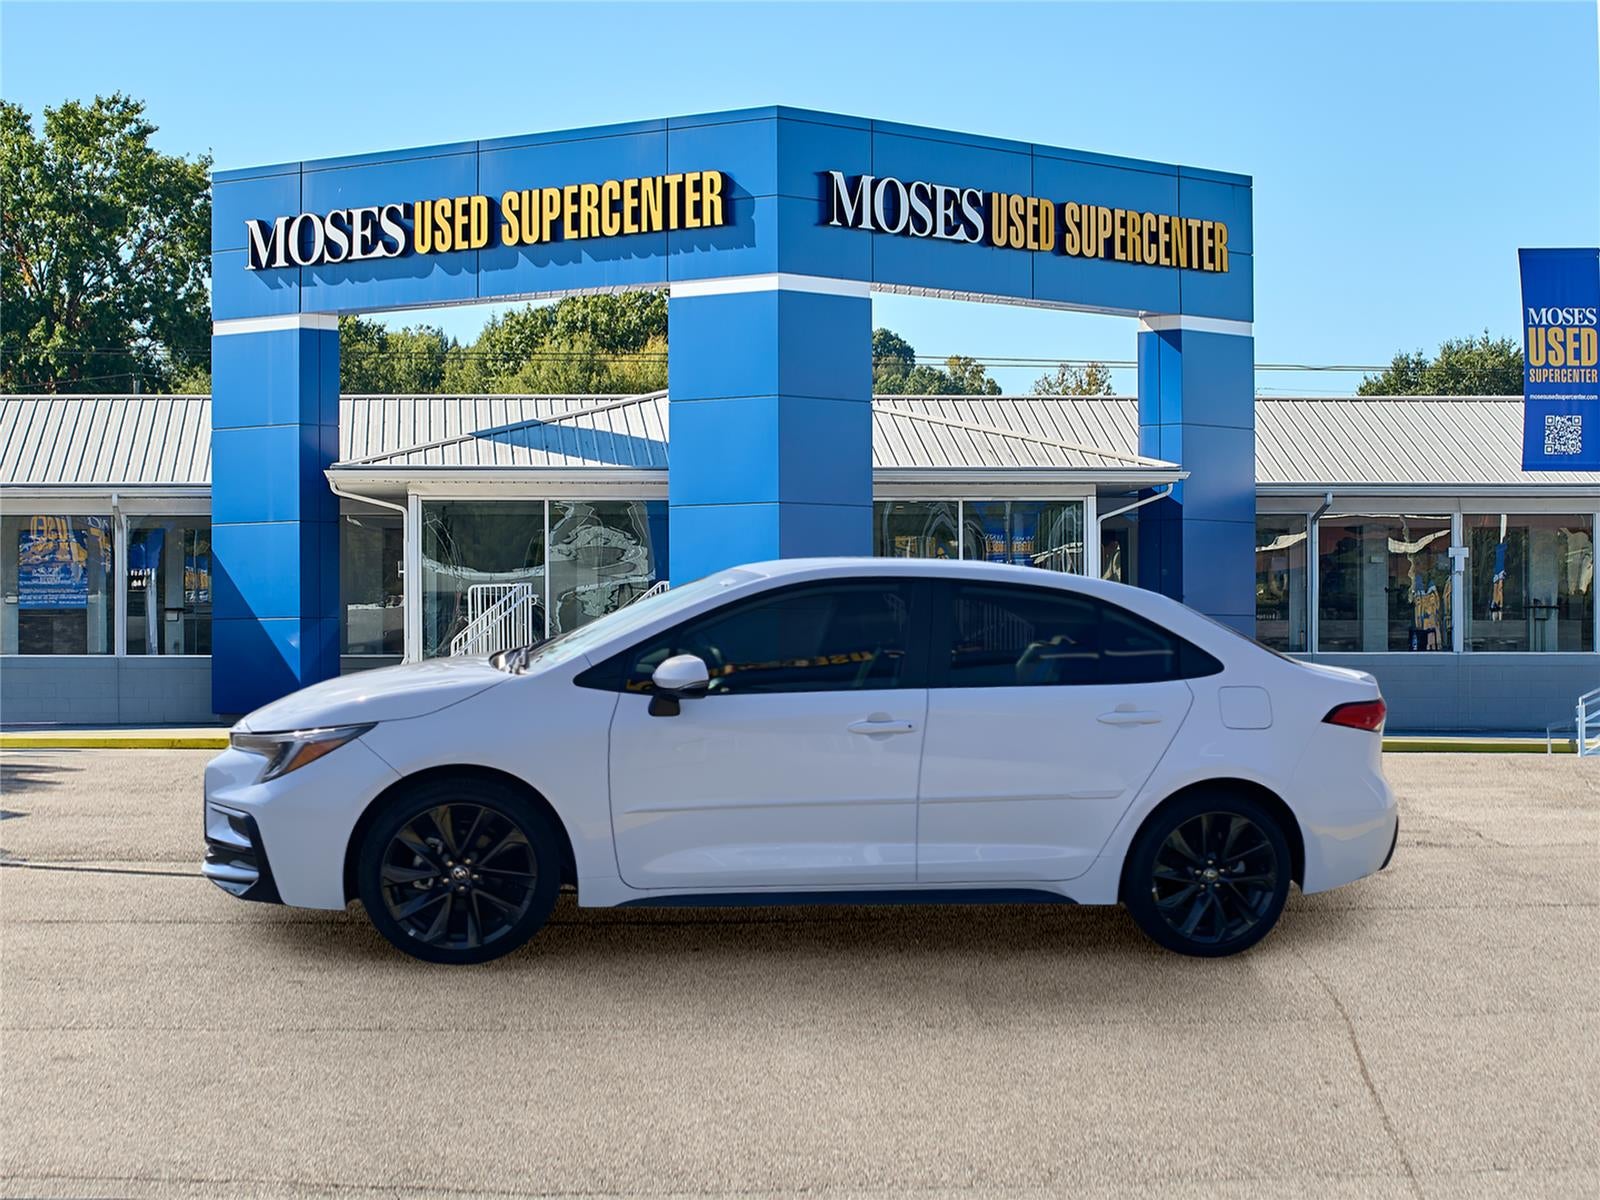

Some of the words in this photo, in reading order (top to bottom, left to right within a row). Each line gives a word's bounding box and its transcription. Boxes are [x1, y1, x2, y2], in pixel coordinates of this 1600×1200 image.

[245, 203, 406, 271] MOSES
[413, 195, 488, 255] USED
[501, 170, 724, 247] SUPERCENTER
[829, 170, 984, 244] MOSES
[991, 192, 1055, 252] USED
[1065, 202, 1229, 273] SUPERCENTER
[1528, 307, 1597, 326] MOSES
[1528, 327, 1598, 367] USED
[1529, 368, 1598, 383] SUPERCENTER
